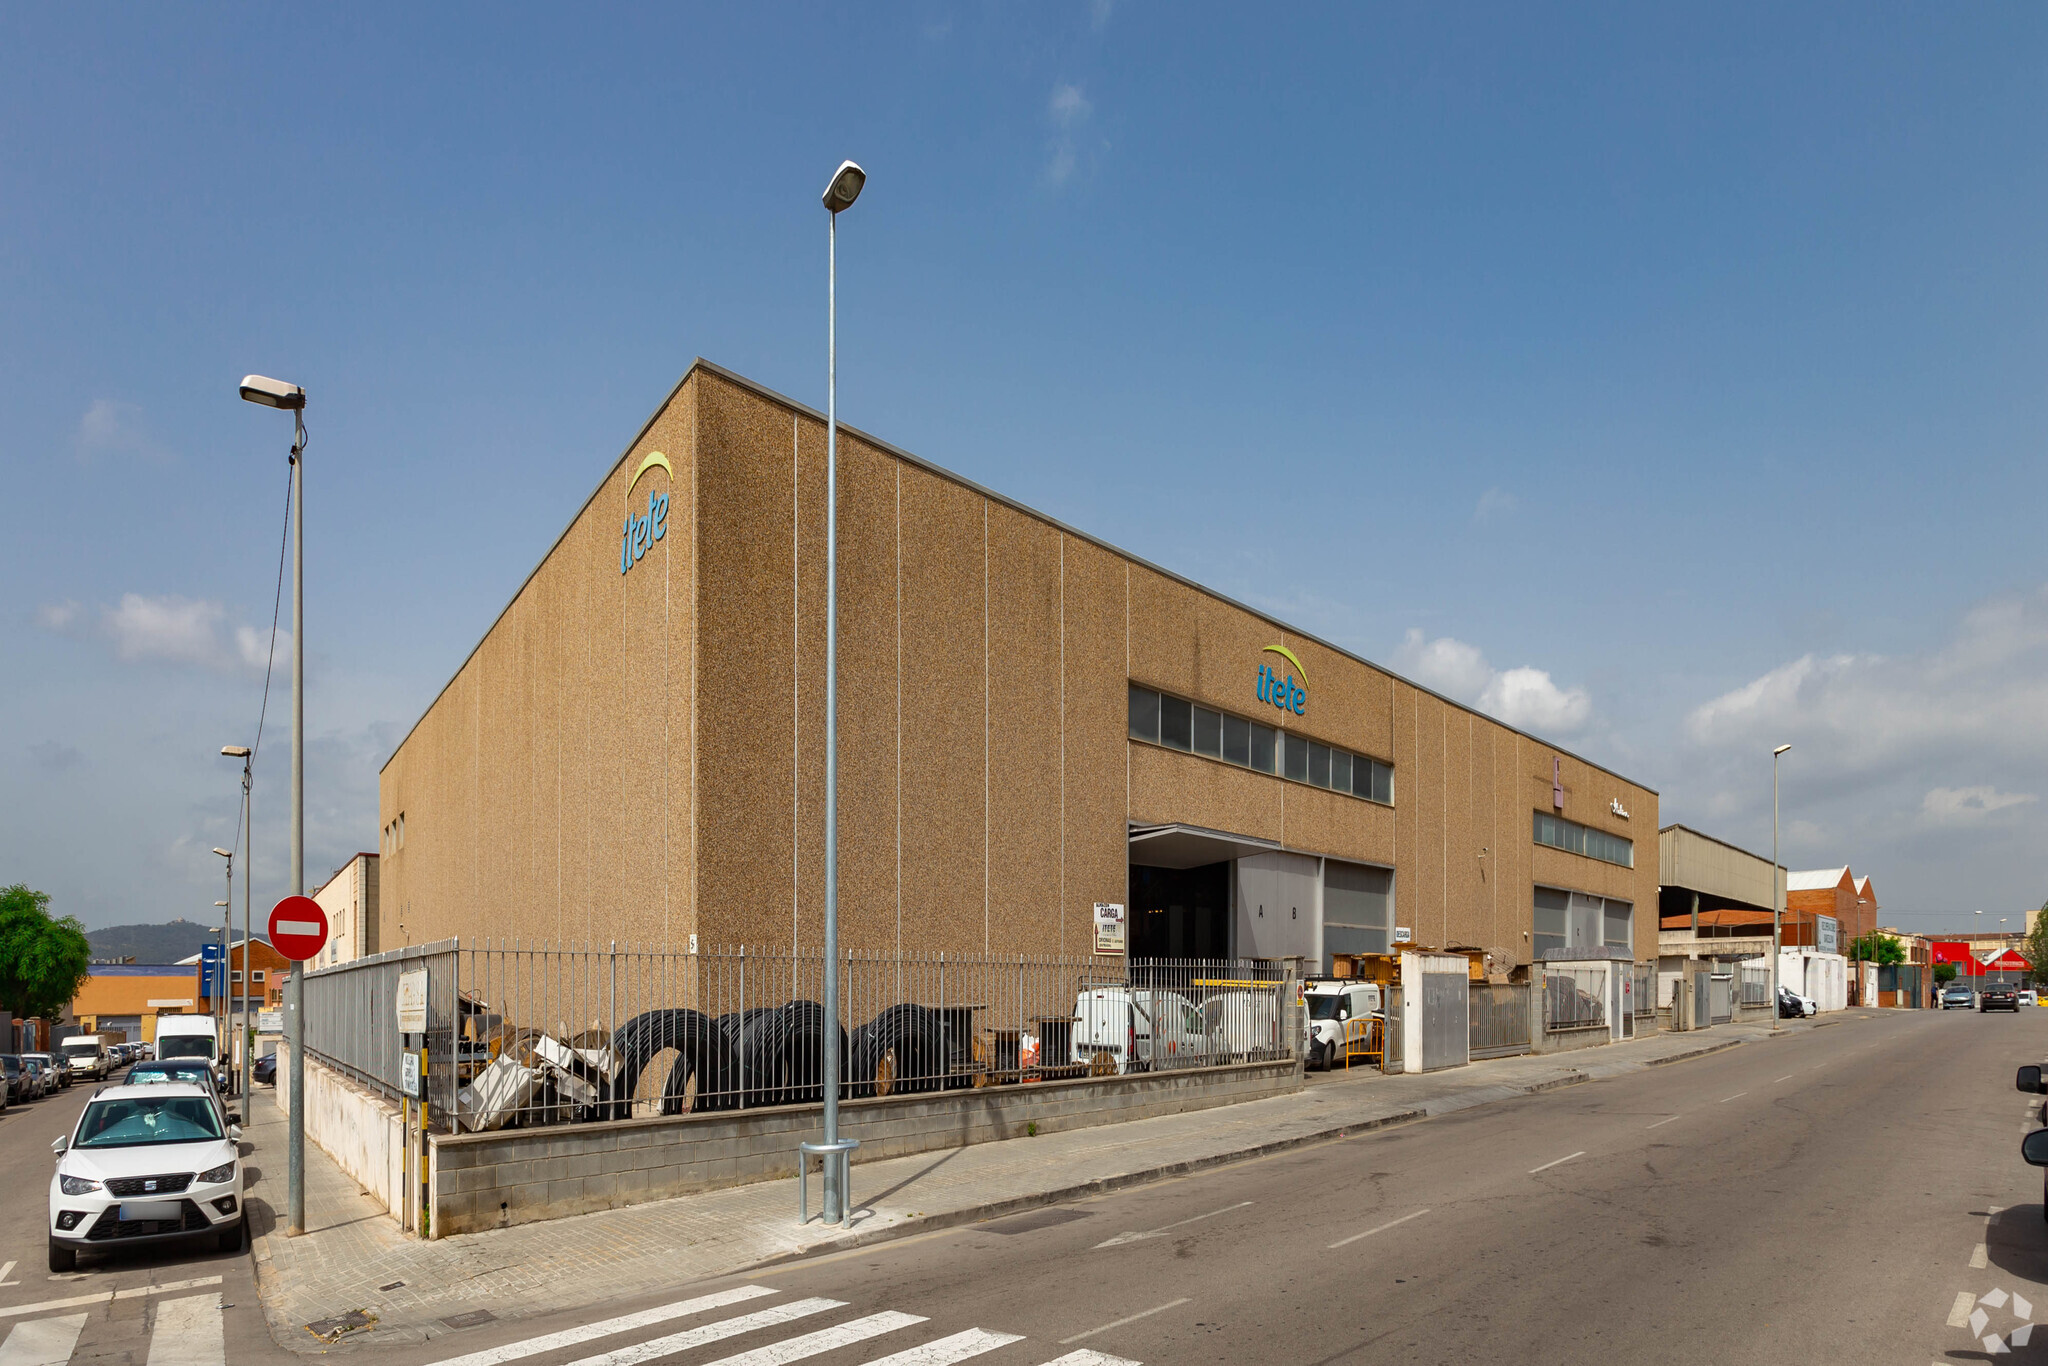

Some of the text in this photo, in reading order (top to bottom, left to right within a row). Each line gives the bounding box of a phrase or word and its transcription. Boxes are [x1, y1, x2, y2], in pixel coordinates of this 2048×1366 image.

[620, 489, 669, 575] itete
[1257, 664, 1306, 715] itete
[1100, 908, 1118, 918] CARGA
[1258, 904, 1297, 919] A B
[1102, 924, 1116, 932] ITETE
